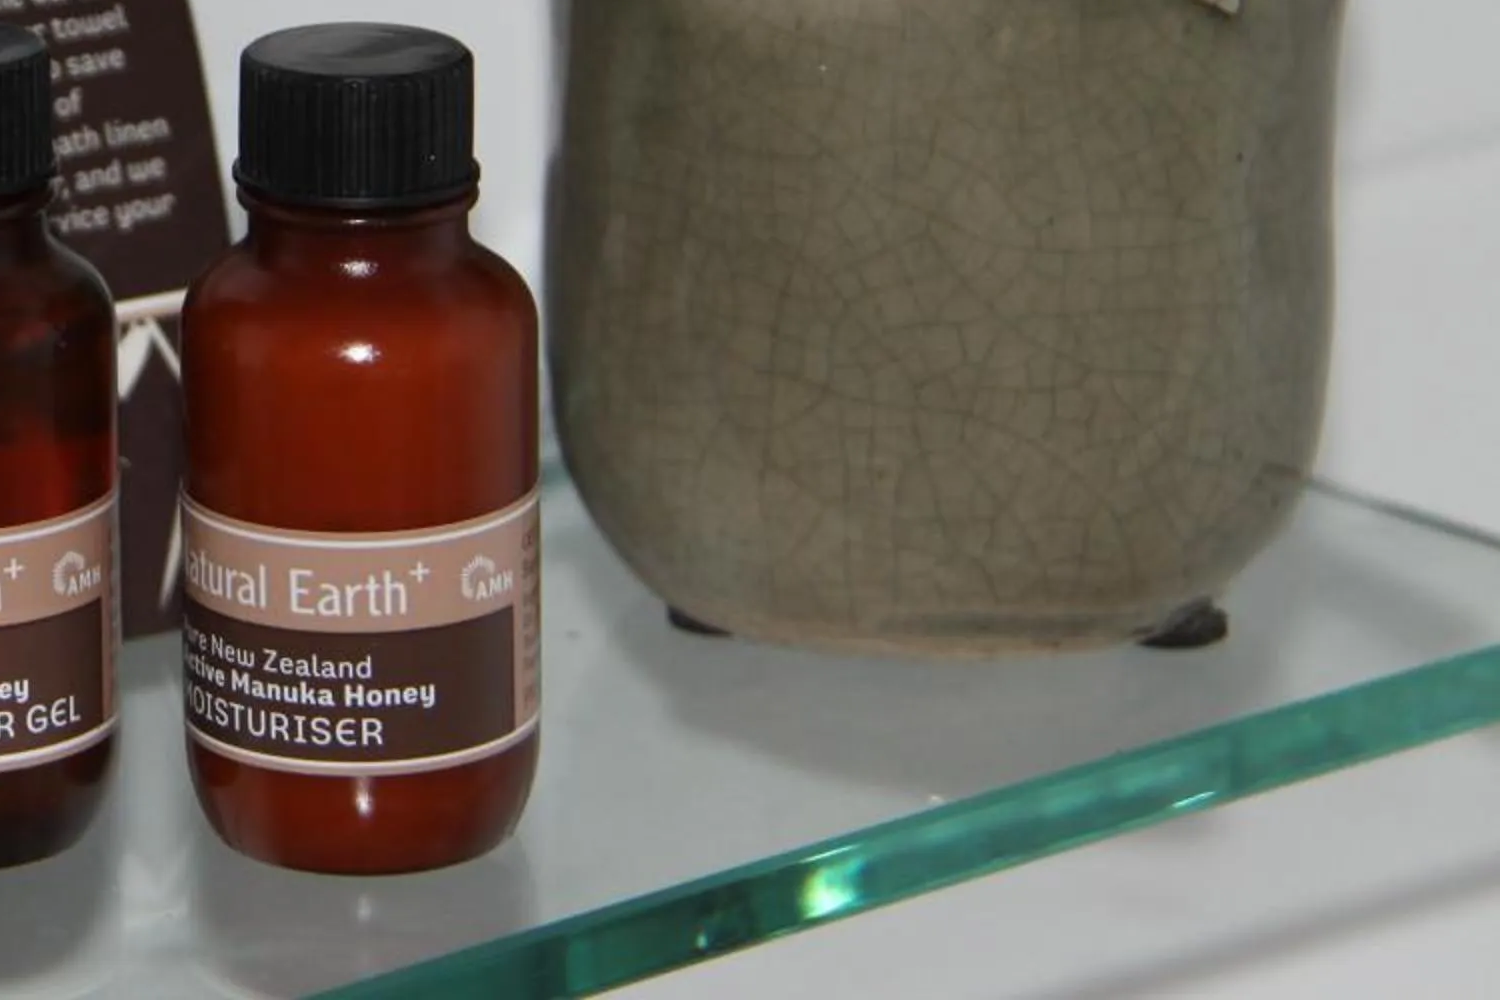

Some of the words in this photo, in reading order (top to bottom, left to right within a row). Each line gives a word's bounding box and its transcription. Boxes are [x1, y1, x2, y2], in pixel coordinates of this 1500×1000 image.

[50, 4, 130, 41] towel
[65, 47, 126, 78] save
[53, 86, 83, 118] of
[104, 117, 172, 148] linen
[74, 158, 123, 193] and
[126, 155, 167, 184] we
[56, 205, 109, 234] vice
[113, 192, 177, 231] your
[185, 548, 269, 611] atural
[210, 633, 257, 669] New
[261, 647, 373, 682] Zealand
[186, 652, 226, 688] ctive
[230, 668, 336, 708] Manuka
[343, 683, 437, 708] Honey
[25, 696, 82, 735] GEL
